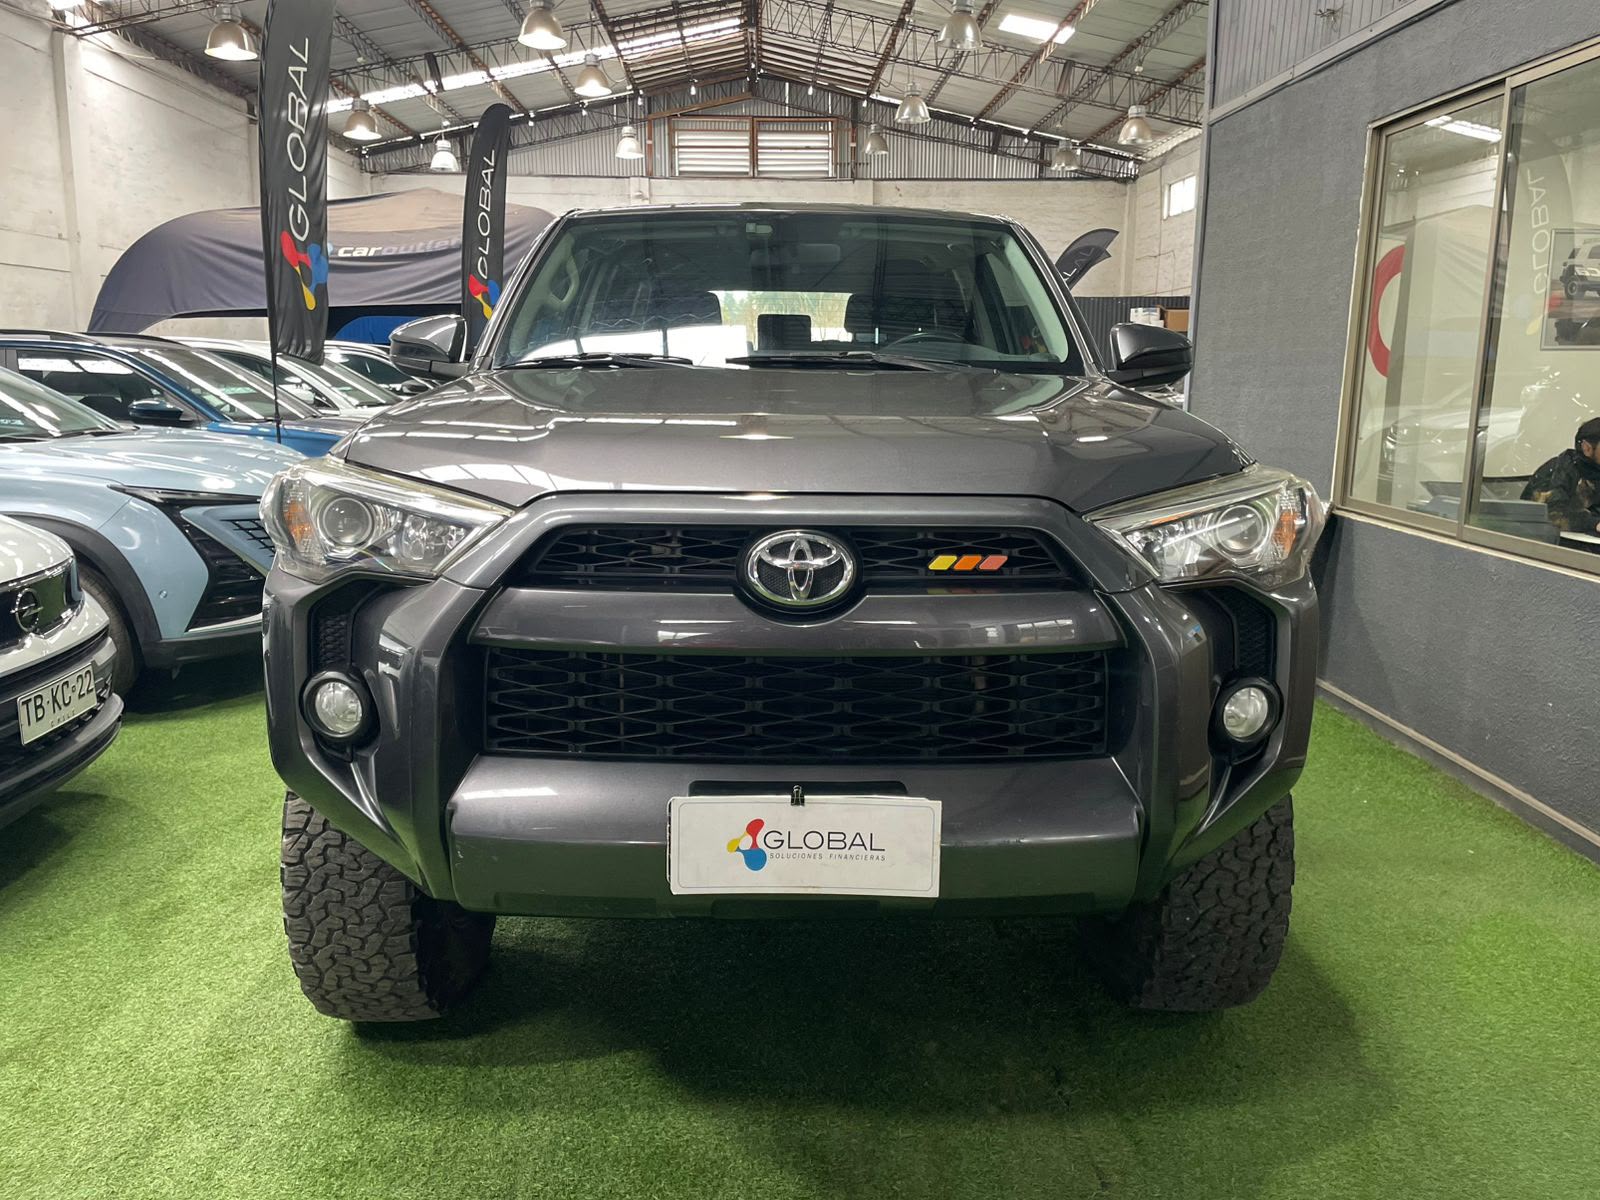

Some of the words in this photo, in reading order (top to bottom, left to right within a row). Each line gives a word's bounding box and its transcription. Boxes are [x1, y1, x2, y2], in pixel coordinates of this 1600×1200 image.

[287, 37, 309, 242] GLOBAL
[477, 149, 495, 280] GLOBAL
[763, 830, 886, 852] GLOBAL
[769, 852, 823, 860] SOLUCIONES
[829, 853, 886, 862] FINANCIERAS
